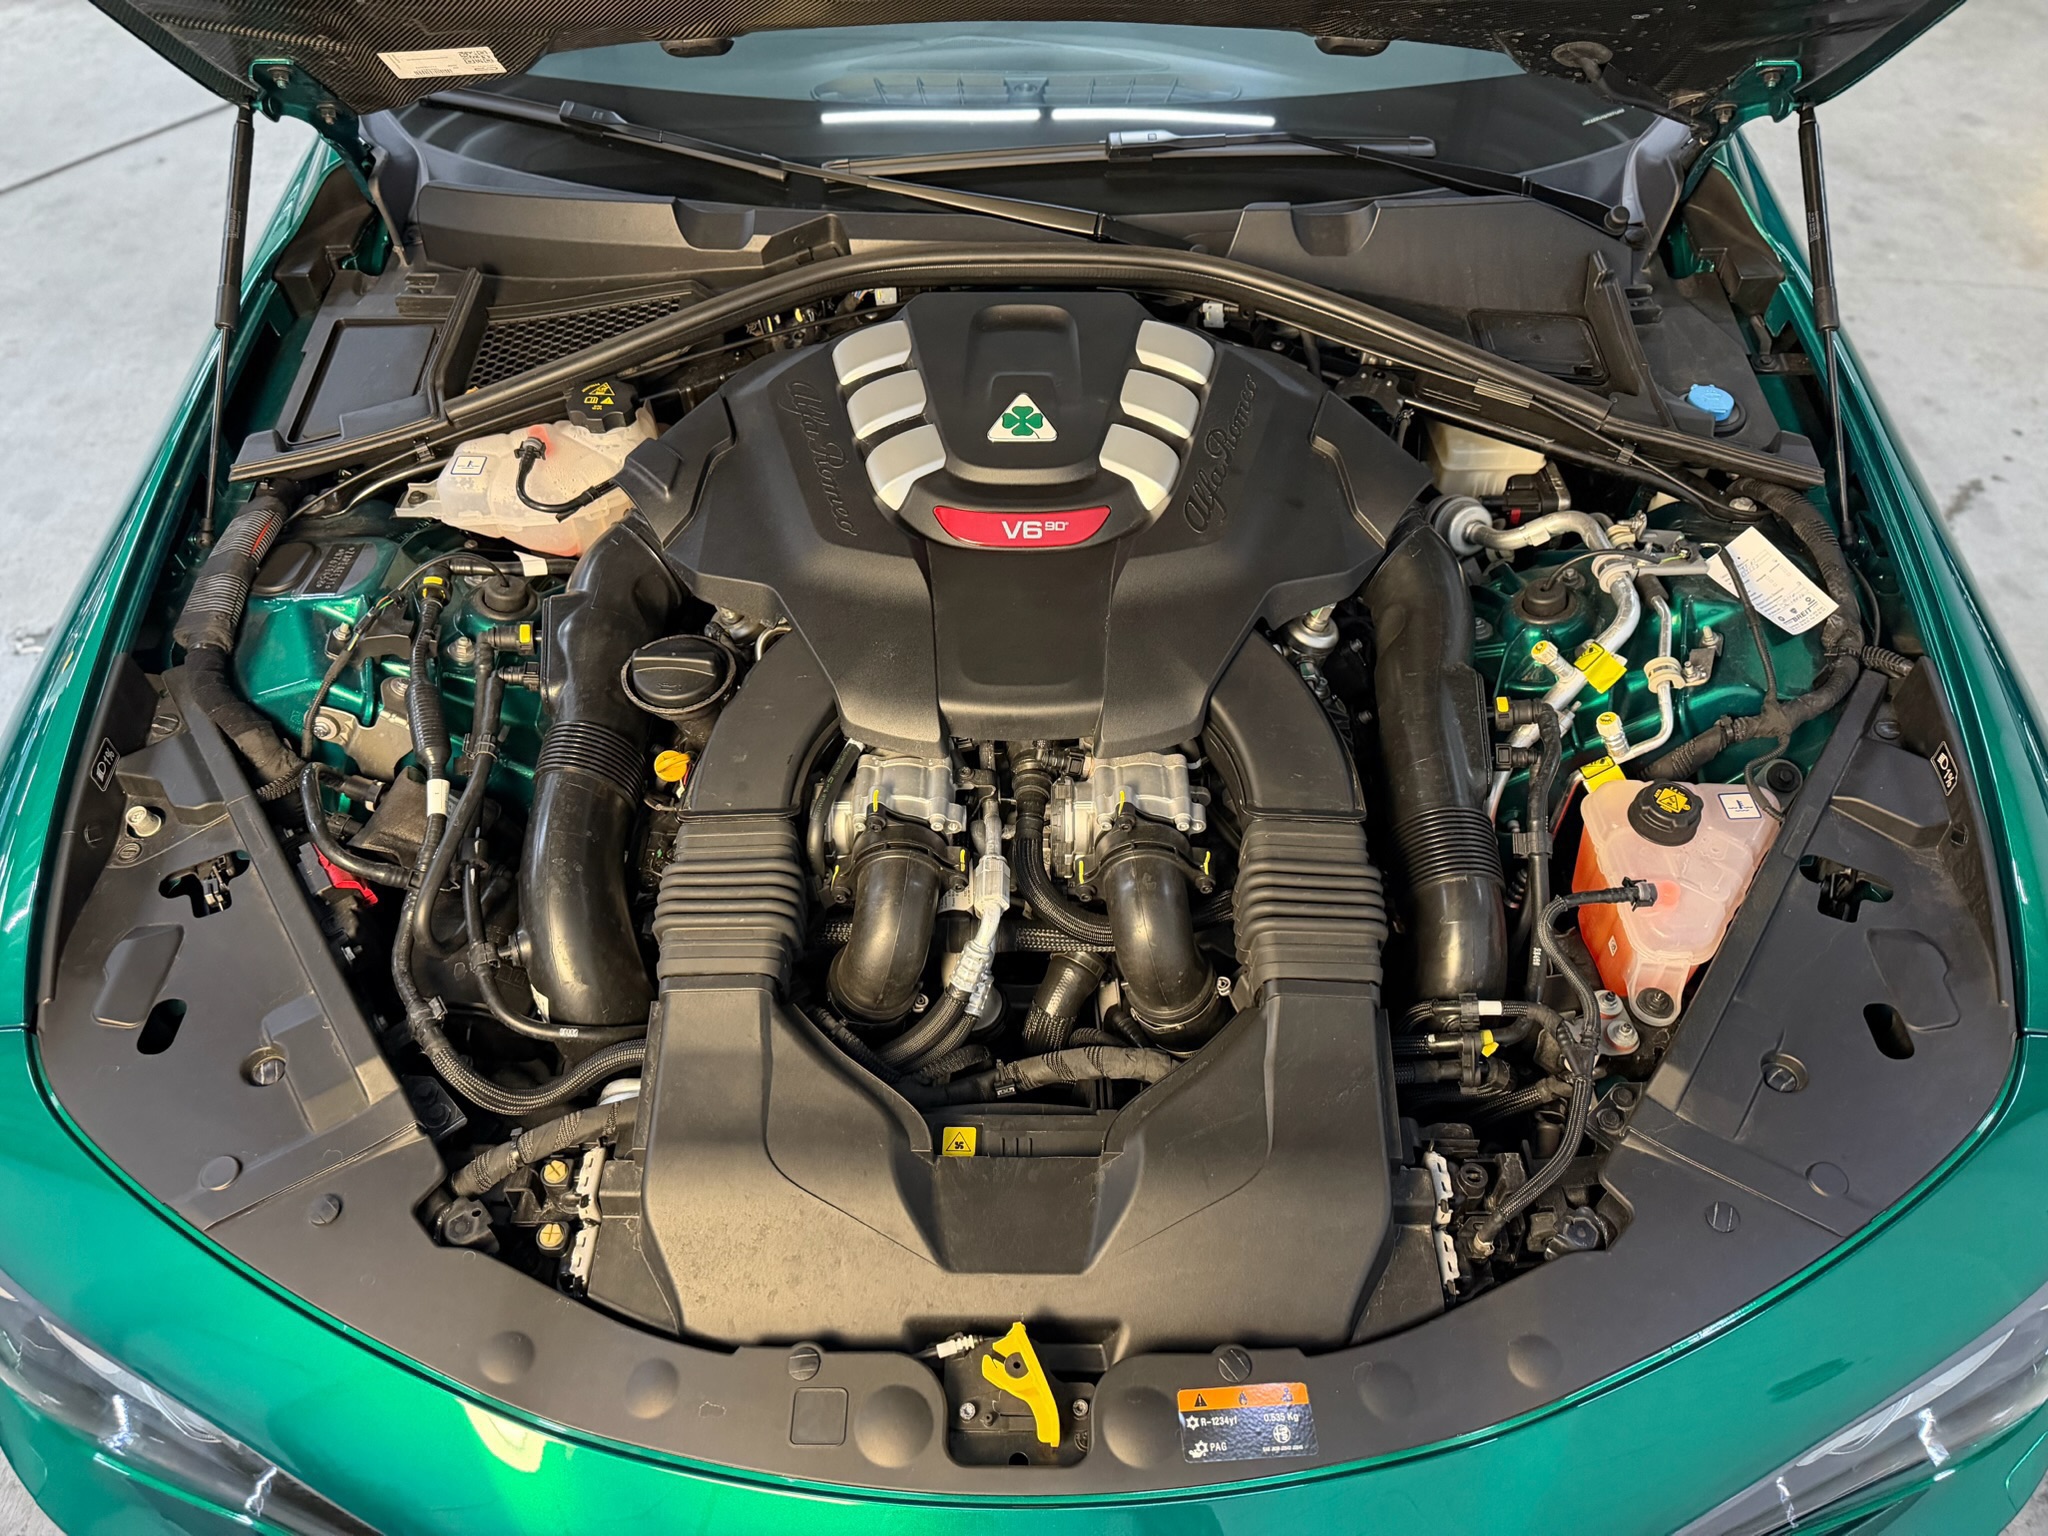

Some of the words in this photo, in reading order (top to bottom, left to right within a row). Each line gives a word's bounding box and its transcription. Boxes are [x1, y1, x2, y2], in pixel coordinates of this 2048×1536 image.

[1204, 373, 1257, 467] Romeo
[776, 381, 830, 441] Alfa
[807, 441, 858, 537] Romeo
[1183, 468, 1229, 534] Alfa
[1001, 520, 1043, 540] V6
[1287, 1411, 1299, 1422] Kg
[1209, 1441, 1228, 1452] PAG
